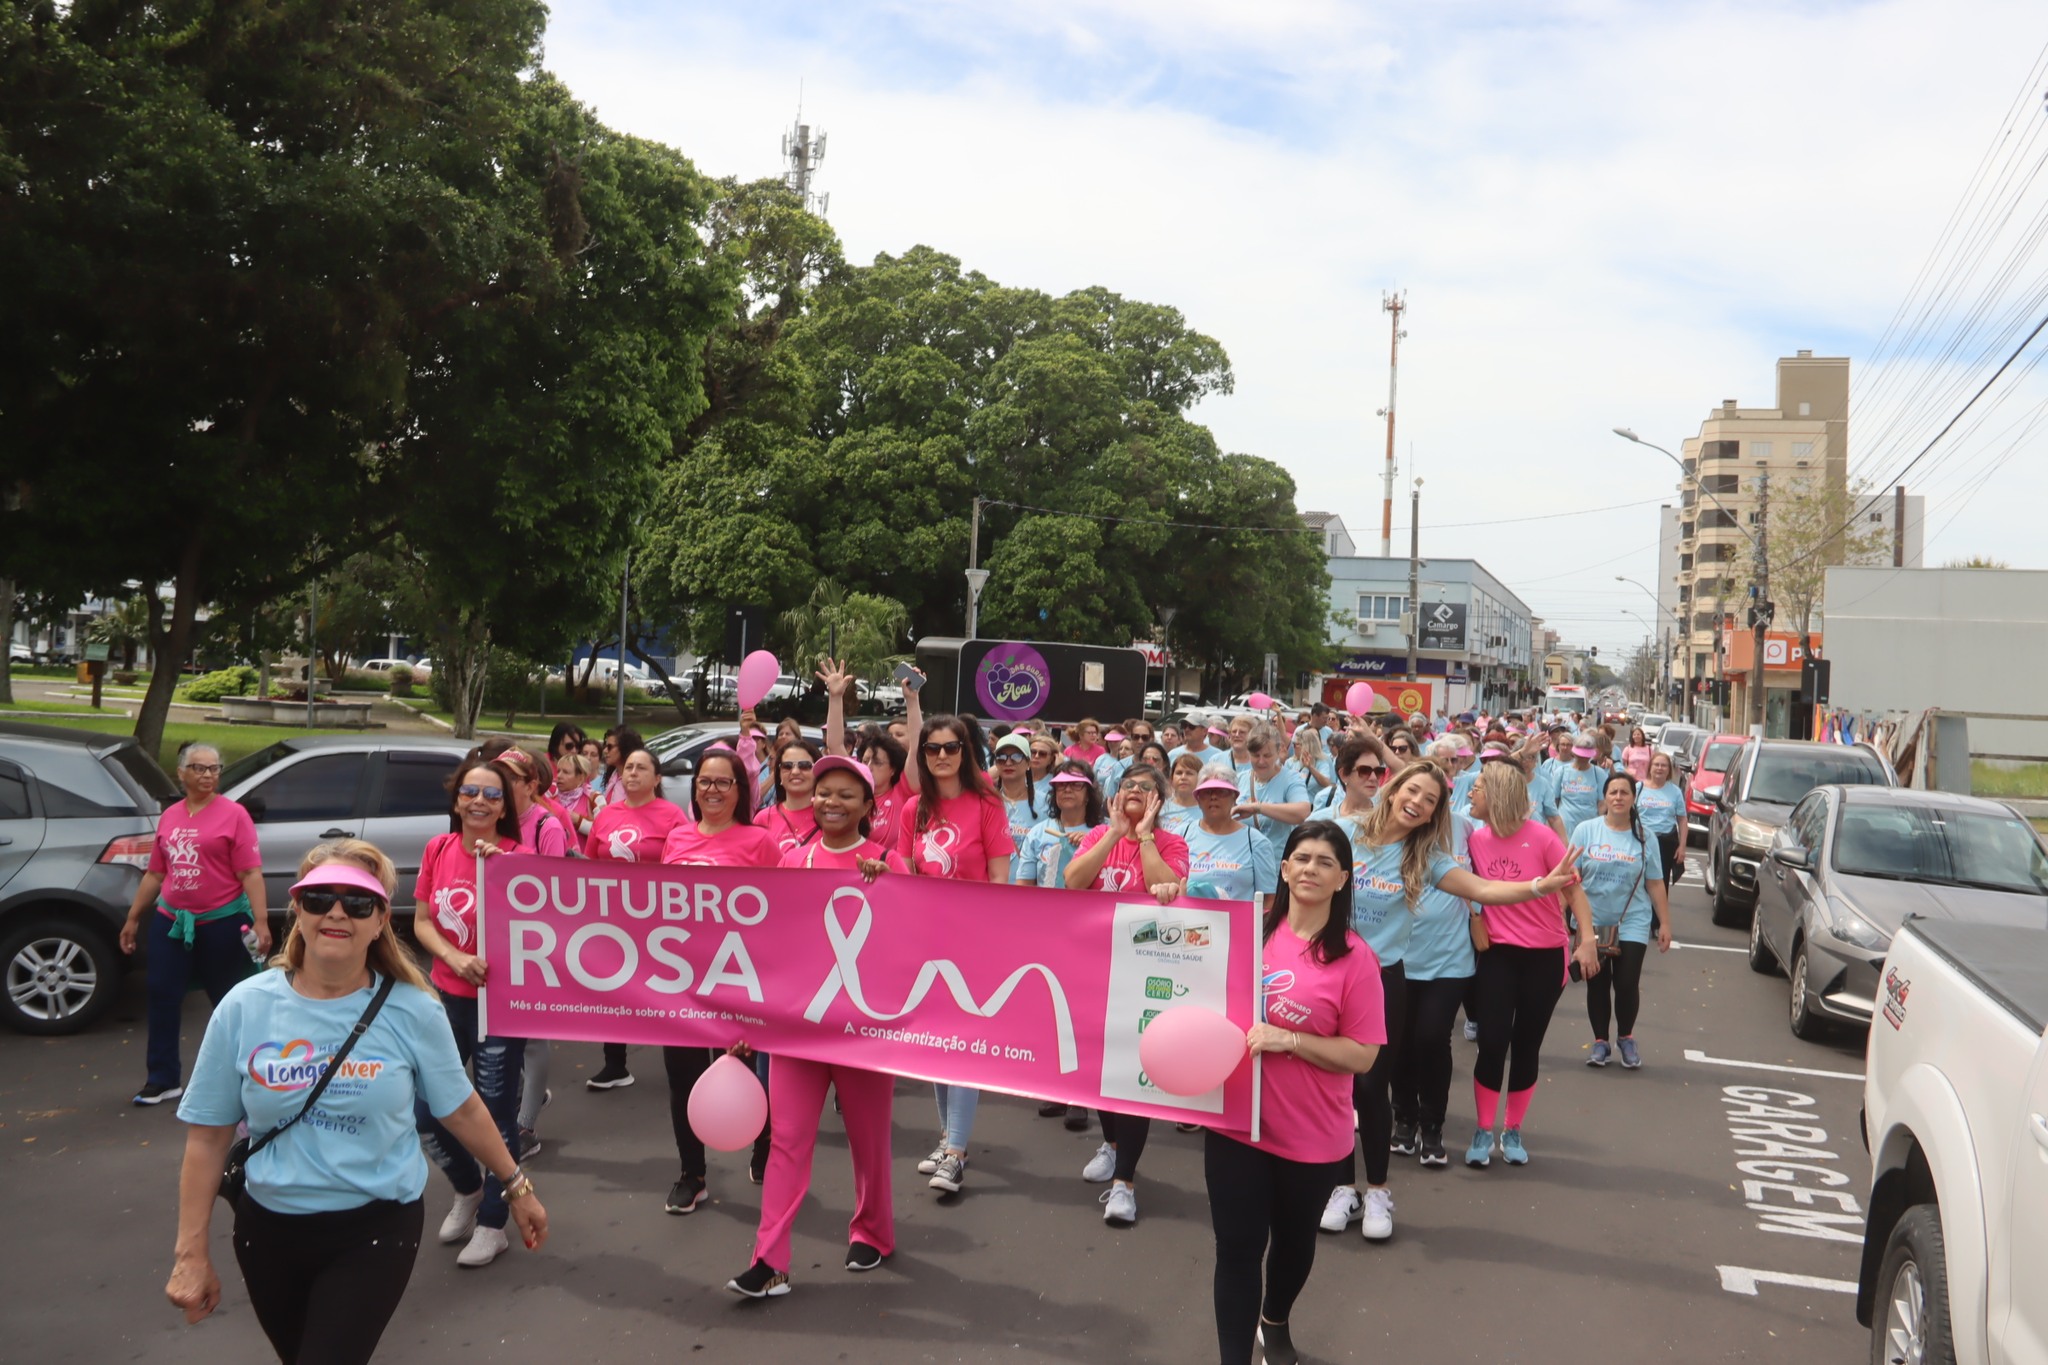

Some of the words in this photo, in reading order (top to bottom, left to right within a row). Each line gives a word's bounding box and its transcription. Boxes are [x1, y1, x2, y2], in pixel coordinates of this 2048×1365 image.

[1427, 620, 1459, 630] Camargo
[1009, 663, 1025, 674] DAS
[506, 874, 769, 926] OUTUBRO
[1372, 908, 1388, 917] VOZ
[508, 919, 765, 1003] ROSA
[1135, 949, 1171, 958] SECRETARIA
[1182, 953, 1203, 962] SAÚDE
[1146, 989, 1170, 999] CERTO
[1277, 994, 1312, 1014] NOVEMBRO
[509, 1000, 531, 1011] Mês
[534, 1001, 547, 1011] da
[549, 1003, 633, 1017] conscientização
[635, 1006, 666, 1018] sobre
[668, 1009, 677, 1018] o
[679, 1007, 718, 1019] Câncer
[720, 1011, 733, 1020] de
[735, 1013, 767, 1026] Mama.
[1269, 1001, 1308, 1024] Azul
[319, 1043, 340, 1053] MÊS
[843, 1021, 856, 1035] A
[860, 1028, 967, 1053] conscientização
[970, 1038, 987, 1055] dá
[991, 1045, 1000, 1056] o
[1004, 1045, 1036, 1062] tom.
[267, 1055, 382, 1087] Longeiver
[337, 1113, 367, 1125] VOZ
[1720, 1085, 1866, 1244] GARAGEM
